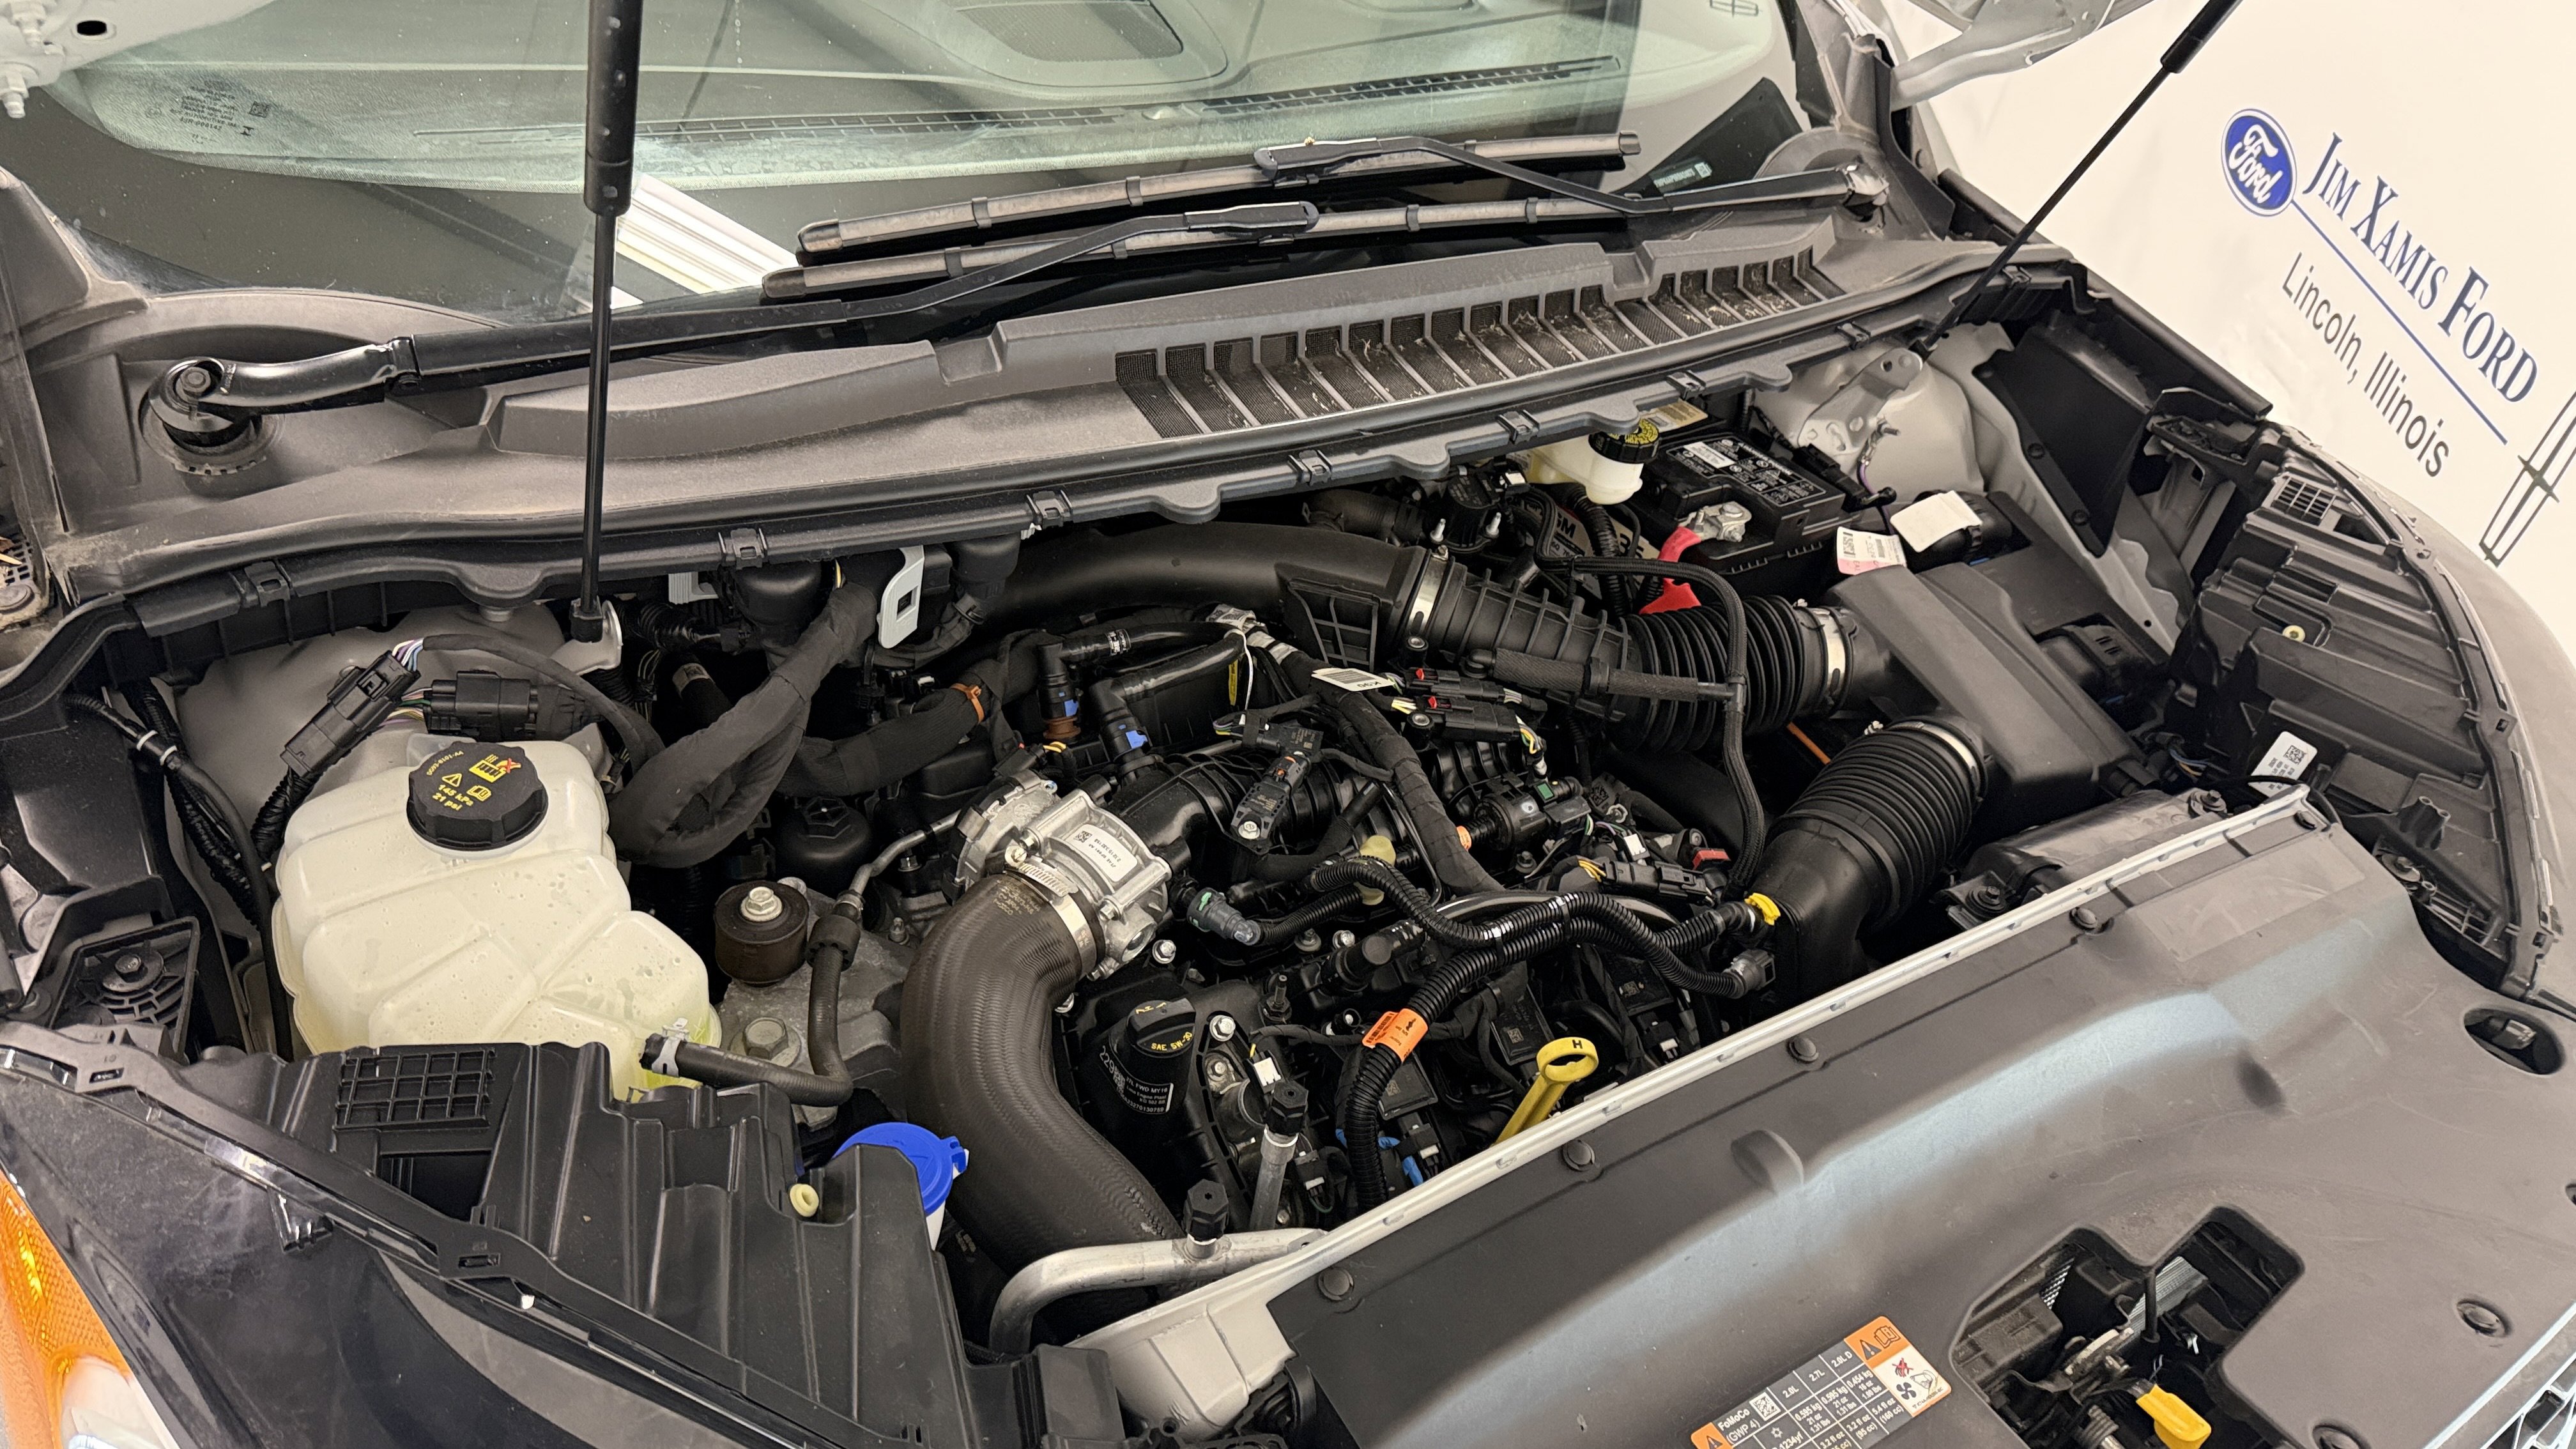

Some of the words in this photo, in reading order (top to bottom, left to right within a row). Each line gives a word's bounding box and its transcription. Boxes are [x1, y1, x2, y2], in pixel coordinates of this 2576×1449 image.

[2228, 123, 2283, 204] Ford
[2303, 132, 2361, 220] JIM
[2350, 176, 2449, 310] XAMIS
[2437, 266, 2538, 403] FORD
[2281, 252, 2363, 385] Lincoln,
[2364, 351, 2450, 478] Illinois
[432, 792, 447, 802] 21
[444, 801, 463, 811] psi
[438, 784, 457, 796] 145
[455, 793, 474, 806] kPa
[1151, 1043, 1167, 1051] SAE
[1170, 1031, 1193, 1050] 5W-30
[1572, 1039, 1583, 1049] H
[1831, 1355, 1848, 1368] 2.0L
[1844, 1351, 1853, 1360] D
[1809, 1369, 1825, 1381] 2.7L
[1862, 1370, 1874, 1378] kg
[1782, 1385, 1800, 1399] 2.0L
[1821, 1390, 1839, 1404] 0.595
[1836, 1386, 1848, 1395] kg
[1795, 1406, 1813, 1422] 0.595
[1810, 1402, 1823, 1411] kg
[1832, 1400, 1841, 1408] 21
[1836, 1406, 1848, 1416] 1.31
[1846, 1402, 1857, 1410] lbs
[1871, 1405, 1883, 1415] 5.4
[1717, 1408, 1751, 1431] FoMoCo
[1806, 1416, 1815, 1425] 21
[1879, 1410, 1894, 1424] (160
[1893, 1404, 1905, 1414] cc)
[1726, 1424, 1749, 1445] (GWP
[1749, 1418, 1761, 1428] 4)
[1810, 1423, 1822, 1433] 1.31
[1846, 1422, 1859, 1432] 3.2
[1855, 1429, 1867, 1440] (95
[1867, 1422, 1878, 1432] cc)
[1820, 1439, 1832, 1449] 3.2
[1840, 1439, 1851, 1447] cc)
